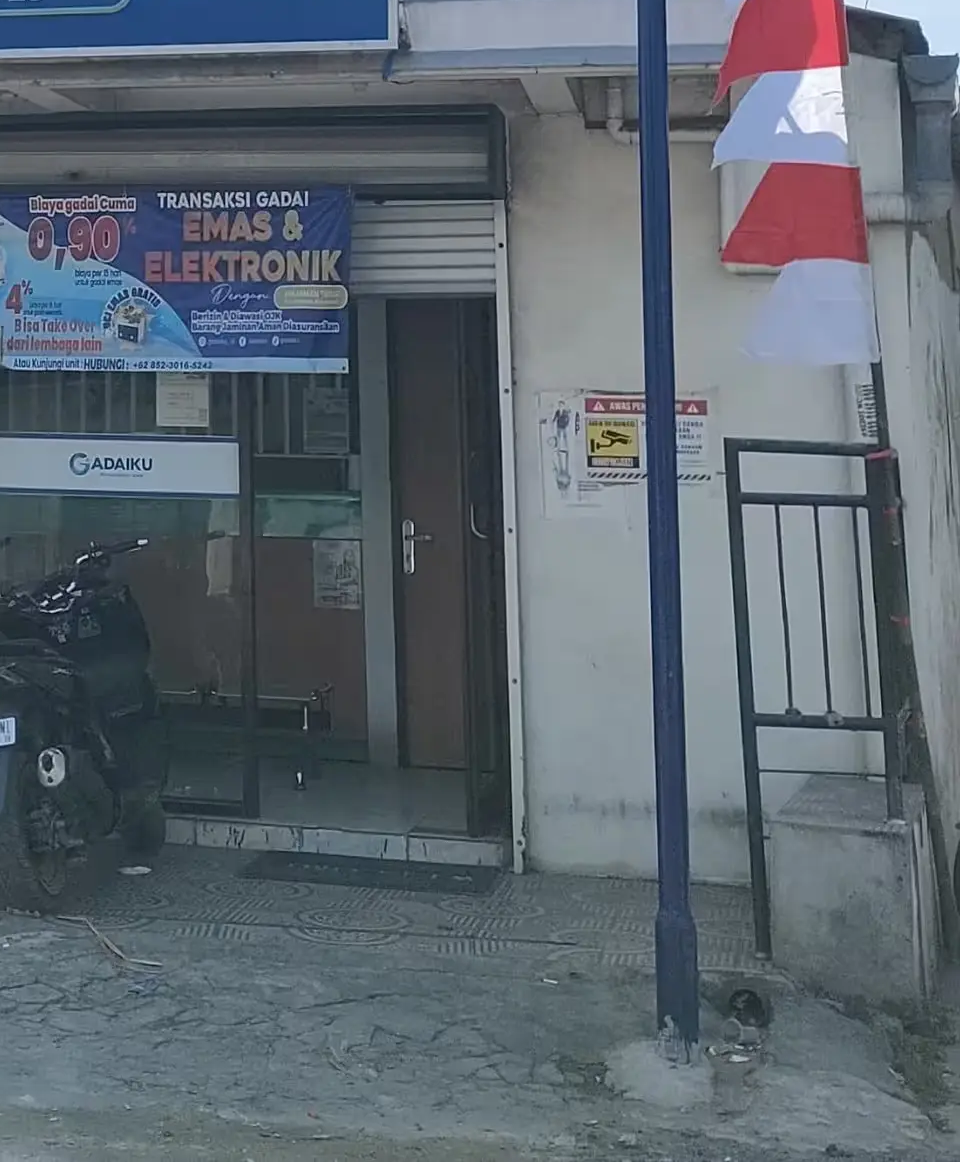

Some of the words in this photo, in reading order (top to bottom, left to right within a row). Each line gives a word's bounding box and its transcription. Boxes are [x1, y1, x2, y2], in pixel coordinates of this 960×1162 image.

[30, 197, 63, 213] Biaya
[65, 198, 97, 214] gadai
[100, 196, 136, 212] Cuma
[157, 192, 251, 209] TRANSAKSI
[256, 190, 309, 208] GADAI
[182, 210, 272, 242] EMAS
[282, 209, 304, 241] &
[144, 249, 342, 283] ELEKTRONIK
[110, 287, 130, 311] EMAS
[131, 287, 162, 308] GRATIS
[210, 283, 269, 309] Dengan
[14, 317, 41, 333] Bisa
[41, 319, 67, 333] Take
[69, 318, 96, 332] Over
[191, 310, 223, 321] Berizin
[230, 310, 263, 321] Diawasi
[264, 311, 282, 320] OJK
[191, 321, 221, 334] Barang
[221, 321, 256, 332] Jaminan
[257, 322, 282, 331] Aman
[283, 320, 339, 332] Diasuransikan
[6, 336, 31, 351] dari
[32, 335, 80, 354] lembaga
[80, 335, 103, 352] lain
[13, 357, 31, 369] Atau
[32, 357, 63, 371] Kunjungi
[132, 361, 149, 369] +62
[69, 452, 153, 476] GADAIKU
